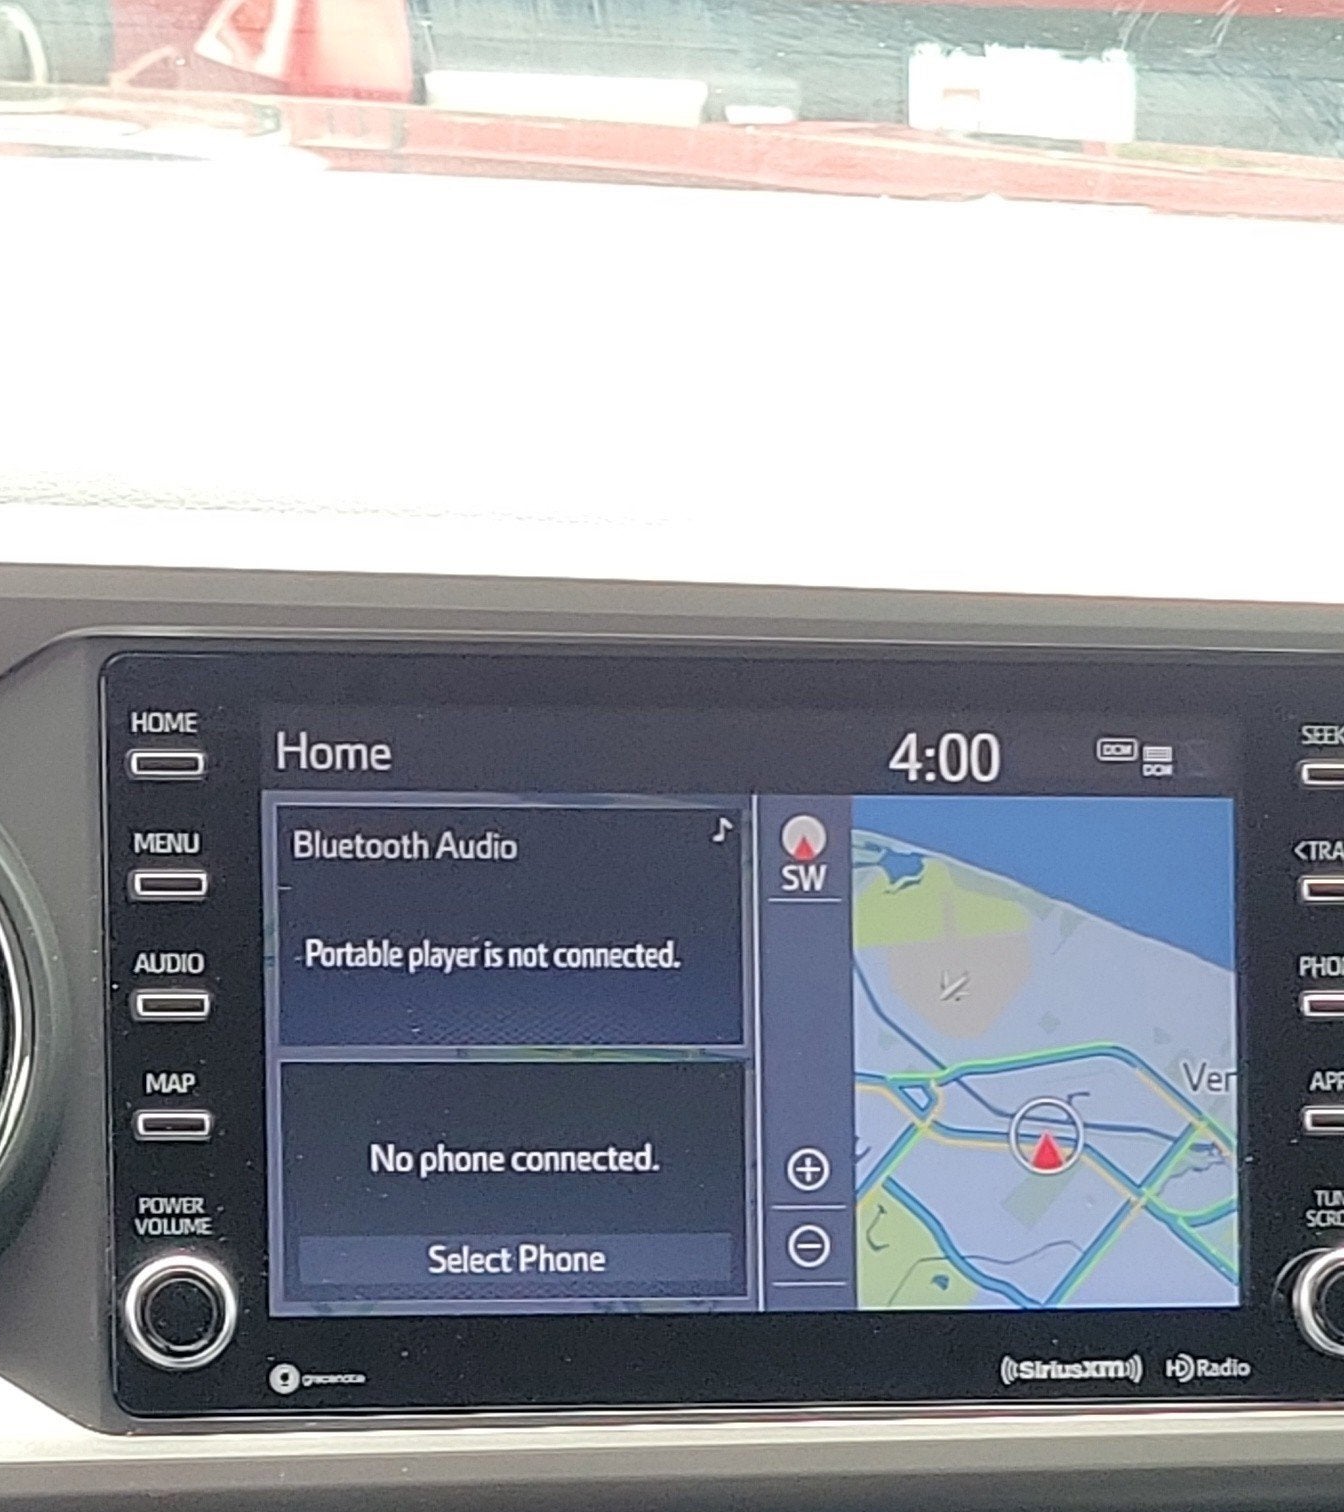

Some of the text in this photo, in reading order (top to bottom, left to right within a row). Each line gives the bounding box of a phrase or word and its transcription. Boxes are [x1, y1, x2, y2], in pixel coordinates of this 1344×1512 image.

[131, 711, 198, 733] HOME
[277, 731, 392, 771] Home
[888, 732, 1000, 782] 4:00
[134, 832, 200, 854] MENU
[293, 829, 518, 860] Bluetooth Audio
[781, 864, 827, 892] SW
[133, 952, 205, 974] AUDIO
[305, 938, 681, 974] Portable player is not connected.
[145, 1072, 196, 1094] MAP
[370, 1142, 660, 1179] No phone connected.
[138, 1197, 205, 1215] POWER
[135, 1217, 212, 1236] VOLUME
[428, 1244, 606, 1274] Select Phone
[1197, 1357, 1252, 1378] Radio
